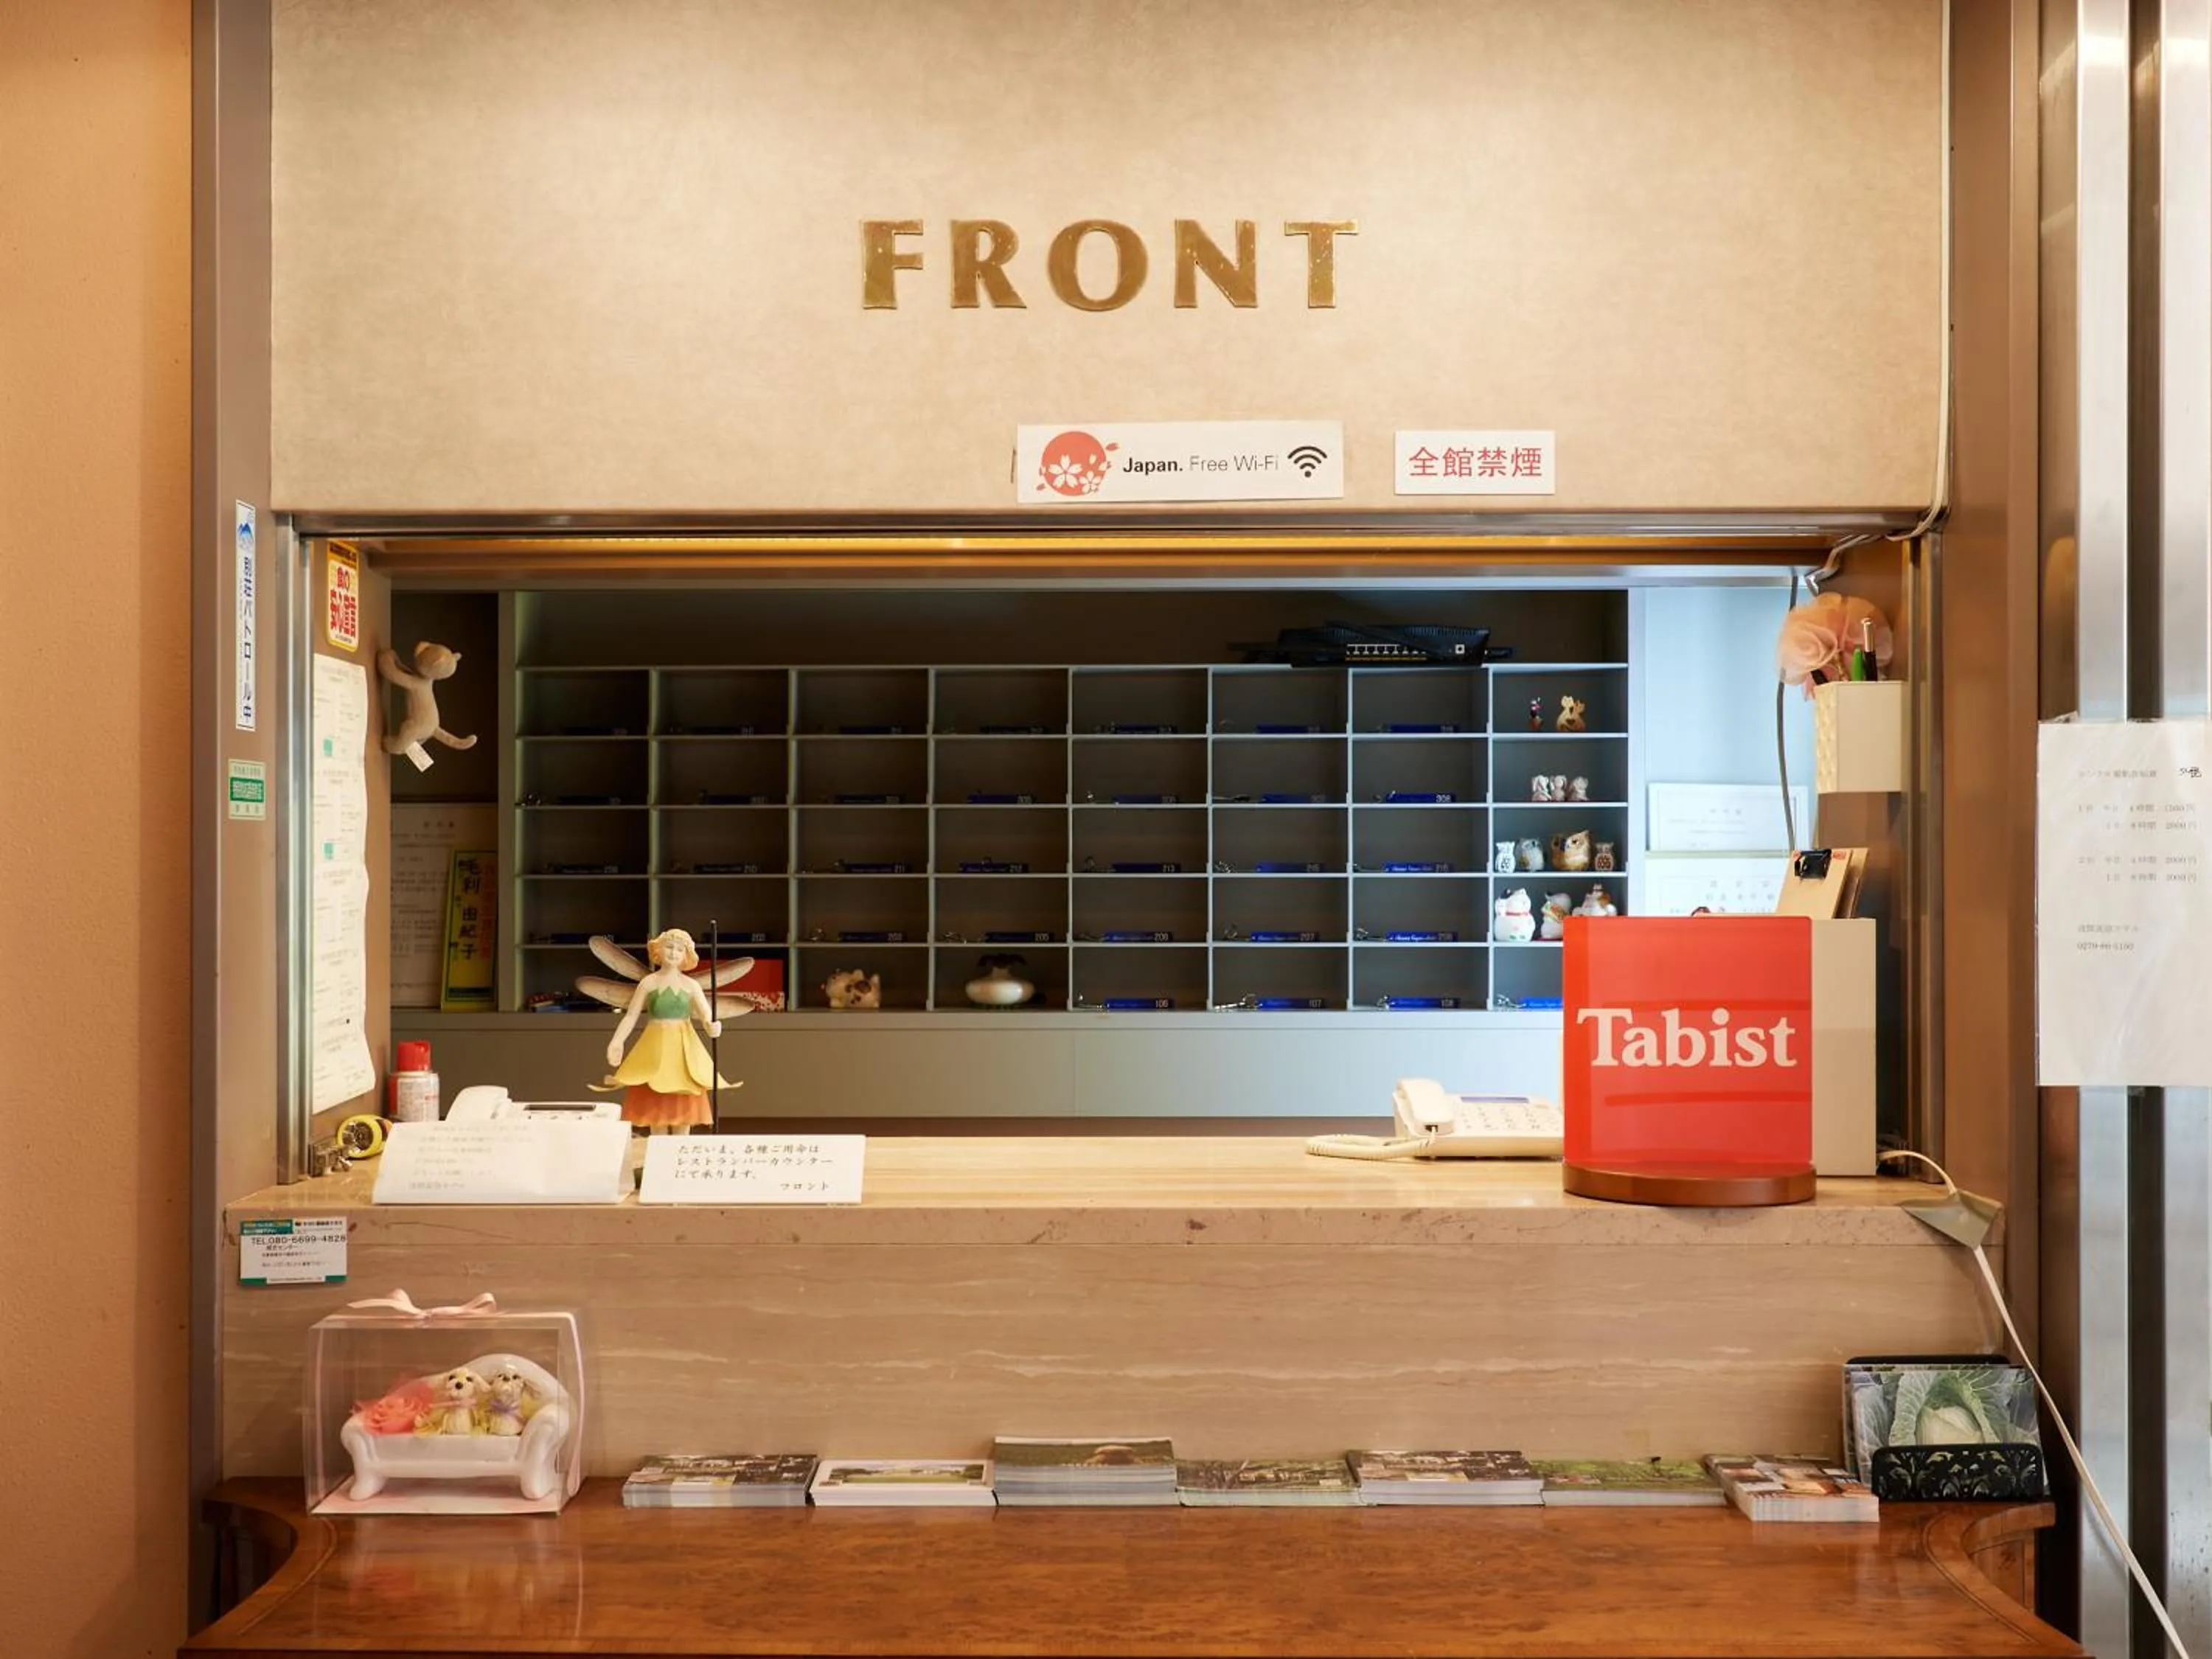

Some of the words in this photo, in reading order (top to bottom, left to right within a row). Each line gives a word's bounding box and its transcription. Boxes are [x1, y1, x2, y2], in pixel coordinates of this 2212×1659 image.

[860, 218, 1359, 312] FRONT
[1122, 456, 1183, 476] Japan.
[1189, 455, 1228, 471] Free
[1233, 454, 1279, 471] Wi-Fi
[1408, 445, 1543, 478] 全館禁煙
[1576, 1007, 1798, 1068] Tabist
